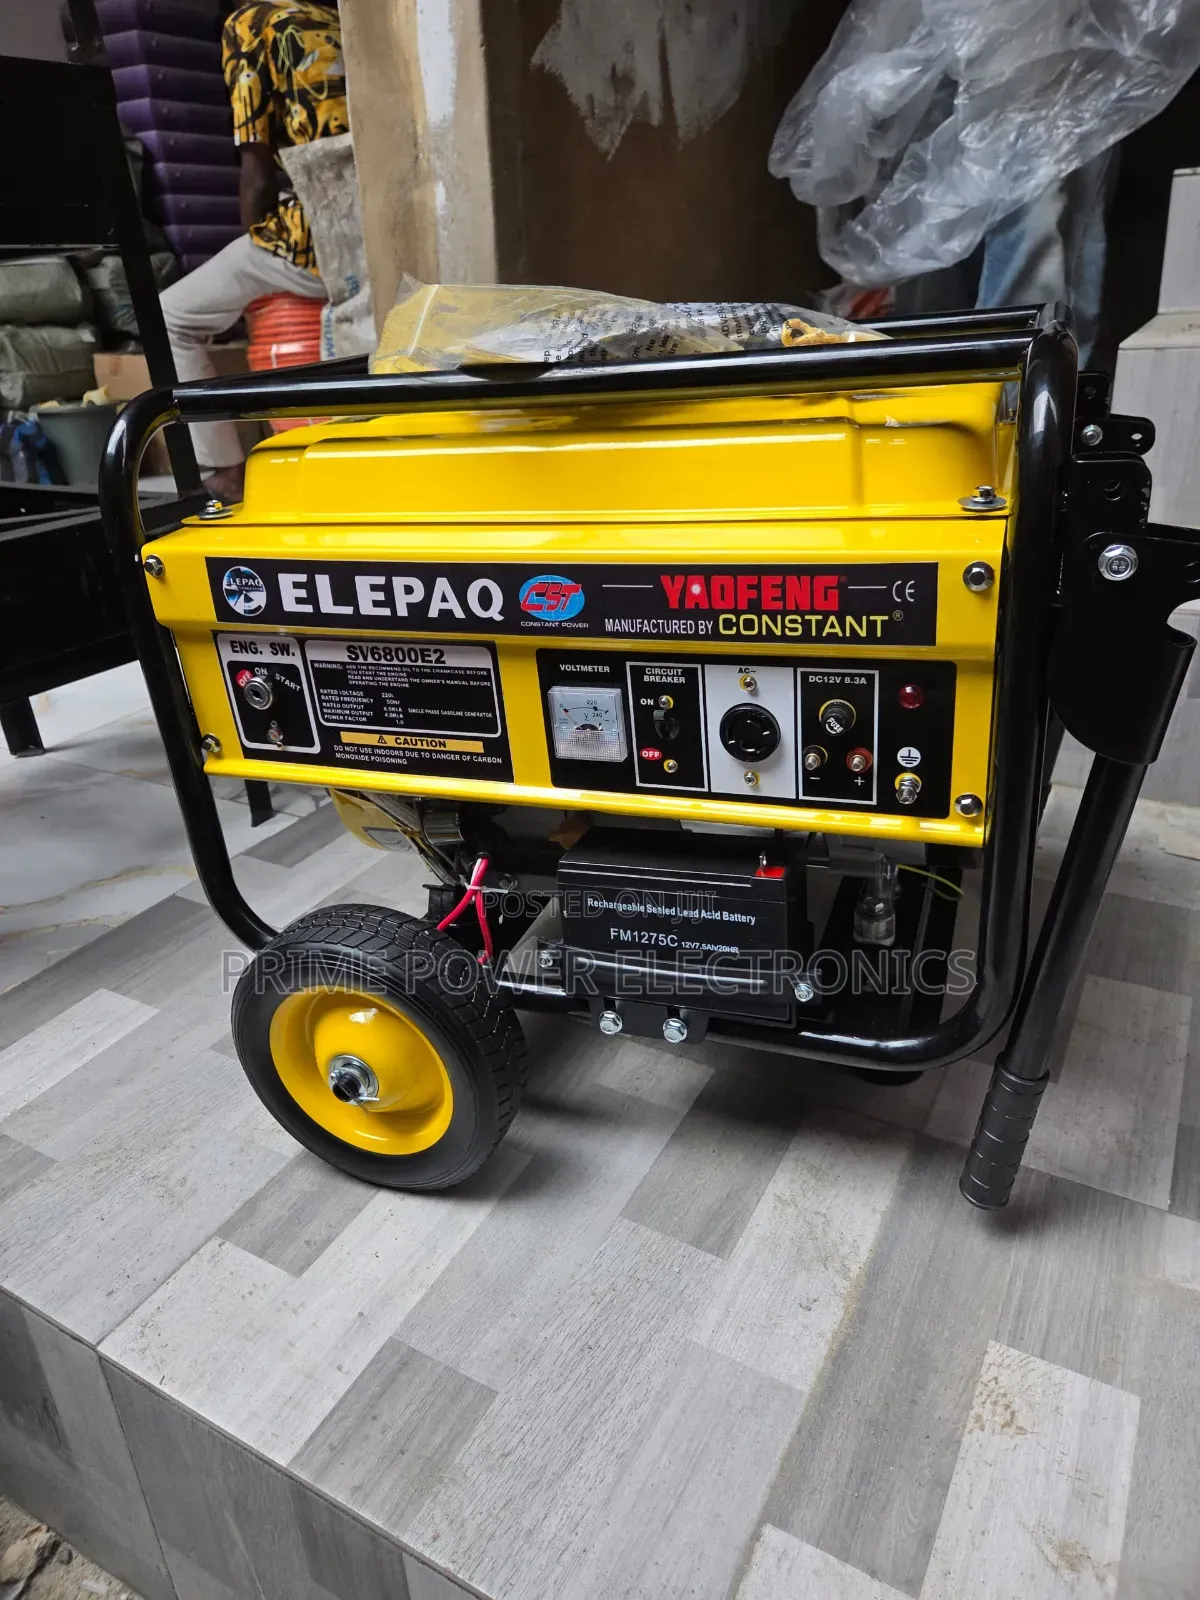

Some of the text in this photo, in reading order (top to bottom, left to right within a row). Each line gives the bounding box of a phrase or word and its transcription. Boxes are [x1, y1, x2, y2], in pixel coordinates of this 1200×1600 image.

[278, 573, 505, 621] ELEPAQ
[521, 583, 582, 612] CST
[660, 575, 839, 611] YAOFENG
[892, 580, 915, 602] CE
[605, 614, 889, 638] MANUFACTURED BY CONSTANT
[230, 640, 295, 657] ENG. SW.
[346, 645, 446, 665] SV6800E2
[254, 667, 268, 676] ON
[560, 664, 610, 673] VOLTMETER
[645, 668, 683, 676] CIRCUIT
[239, 671, 251, 687] OFF
[275, 673, 301, 692] START
[644, 675, 686, 684] BREAKER
[808, 675, 867, 685] DC12V 8.3A
[640, 698, 654, 706] ON
[827, 717, 844, 733] FUSE
[395, 737, 447, 748] CAUTION
[336, 753, 408, 764] MONOXIDE POISONING
[473, 756, 503, 764] CARBON
[642, 750, 660, 758] OFF
[588, 898, 756, 926] Rechargeable Sealed Lead Acid Battery
[610, 927, 739, 954] FM1275C 12V7.5Ah/20HR
